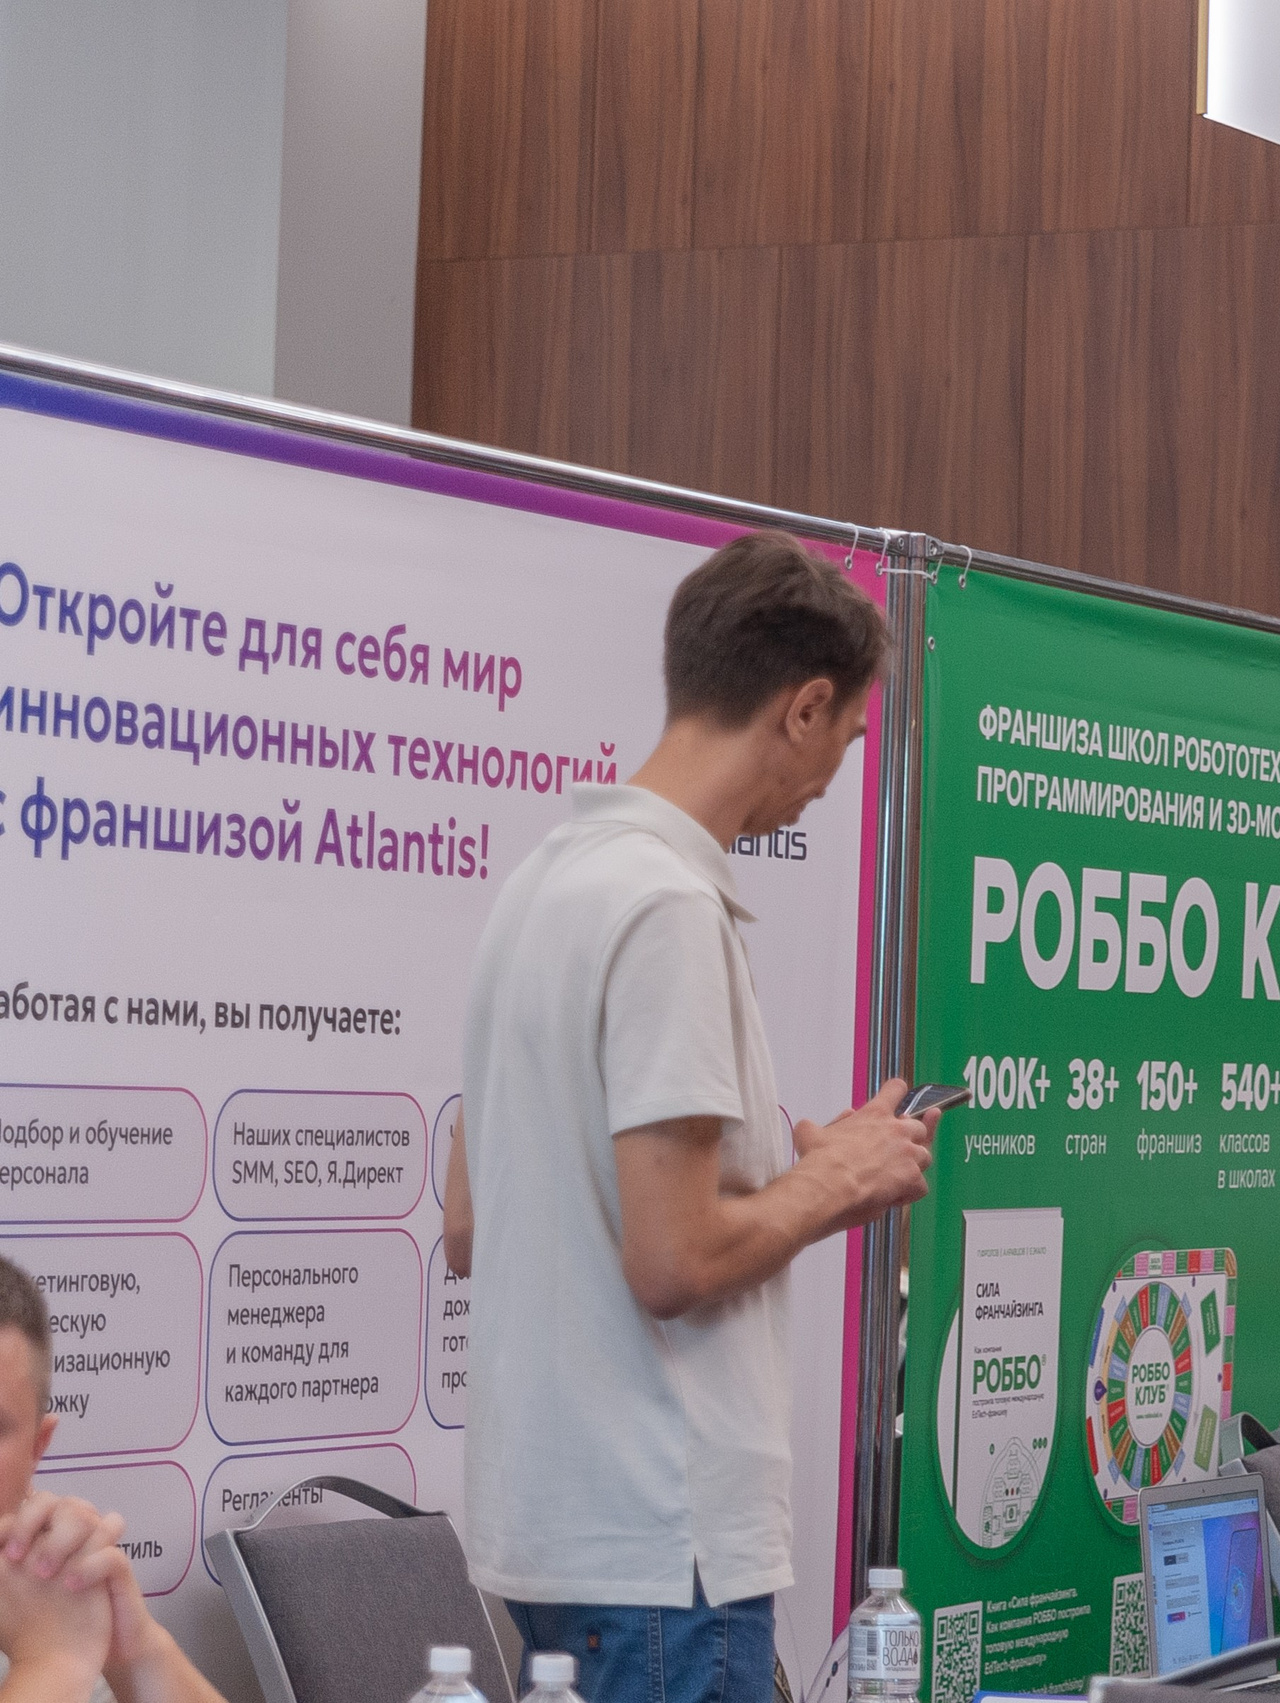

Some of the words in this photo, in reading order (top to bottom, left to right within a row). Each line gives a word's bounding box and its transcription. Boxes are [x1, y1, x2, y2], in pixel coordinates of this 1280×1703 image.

[0, 562, 227, 657] Откройте
[238, 615, 323, 674] для
[334, 624, 430, 686] себя
[443, 646, 523, 712] мир
[978, 704, 1104, 758] ФРАНШИЗА
[1108, 724, 1169, 768] ШКОЛ
[389, 733, 617, 796] технологий
[976, 765, 1205, 831] ПРОГРАММИРОВАНИЯ
[1208, 797, 1223, 832] И
[20, 776, 303, 864] франшизой
[314, 806, 490, 881] Atlantis!
[969, 855, 1220, 999] РОББО
[104, 996, 119, 1024] с
[127, 997, 206, 1035] нами,
[214, 1002, 250, 1030] вы
[259, 1003, 402, 1042] получаете:
[1066, 1058, 1120, 1110] 38+
[1136, 1060, 1198, 1111] 150+
[0, 1119, 63, 1151] одбор
[70, 1126, 80, 1146] и
[85, 1119, 173, 1152] обучение
[232, 1122, 291, 1148] Наших
[295, 1125, 411, 1153] специалистов
[964, 1132, 1036, 1163] учеников
[1065, 1132, 1107, 1161] стран
[1136, 1128, 1202, 1161] франшиз
[1219, 1132, 1271, 1154] классов
[232, 1160, 279, 1188] SMM,
[284, 1161, 323, 1188] SEO,
[327, 1160, 404, 1190] Я.Директ
[1217, 1169, 1225, 1189] в
[1229, 1168, 1276, 1189] школах
[33, 1272, 141, 1299] етинговую,
[228, 1260, 359, 1293] Персонального
[975, 1282, 1000, 1298] СИЛА
[227, 1302, 326, 1330] менеджера
[975, 1300, 1044, 1321] ФРАНЧАЙЗИНГА
[226, 1346, 237, 1364] и
[241, 1342, 315, 1368] команду
[318, 1340, 350, 1363] для
[442, 1335, 469, 1352] гот
[54, 1349, 171, 1376] изационную
[972, 1354, 1042, 1395] РОББО
[1131, 1361, 1170, 1384] РОББО
[225, 1376, 297, 1404] каждого
[301, 1374, 380, 1401] партнера
[1135, 1384, 1166, 1406] КЛУБ
[1033, 1609, 1057, 1624] РОББО
[882, 1630, 919, 1647] ТОЛЬКО
[882, 1647, 914, 1667] ВОДА
